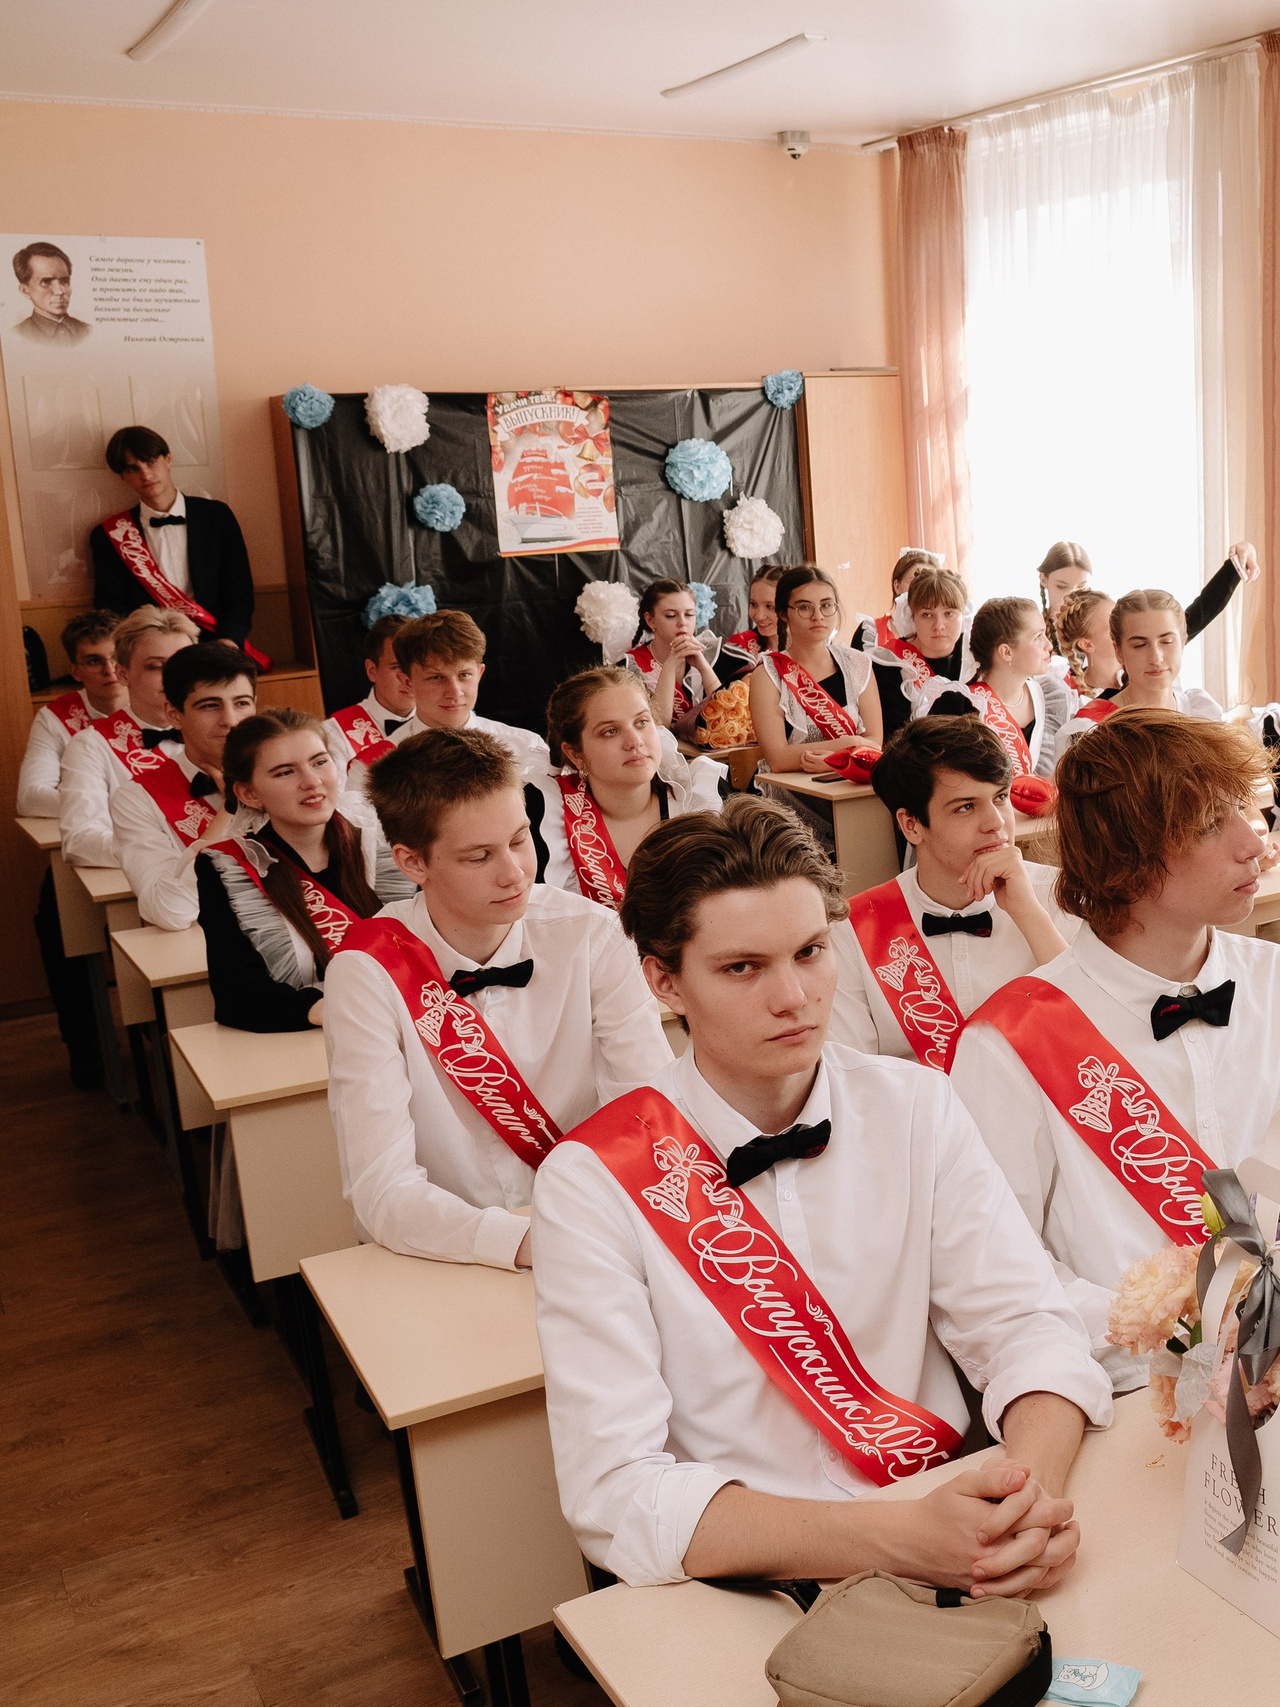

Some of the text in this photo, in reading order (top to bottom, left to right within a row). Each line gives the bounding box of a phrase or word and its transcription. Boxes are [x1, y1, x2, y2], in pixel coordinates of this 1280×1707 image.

[495, 397, 528, 415] УДАЧИ
[503, 406, 576, 429] ВЫПУСКНИК!
[688, 1215, 950, 1481] Выпускник 2025
[1211, 1452, 1267, 1506] FREH
